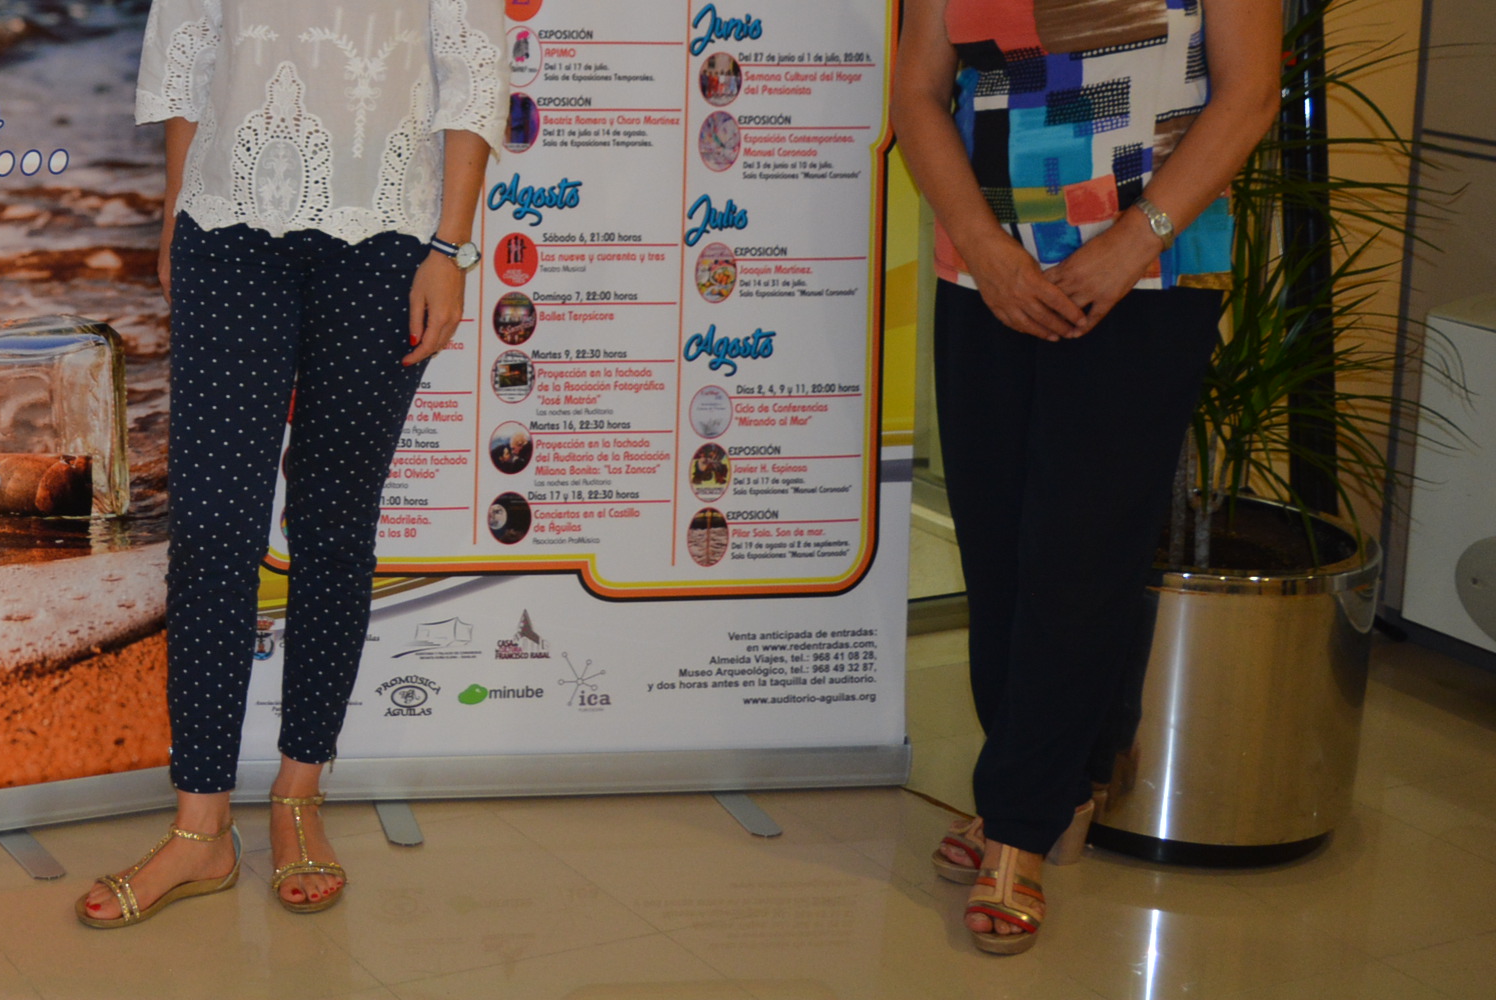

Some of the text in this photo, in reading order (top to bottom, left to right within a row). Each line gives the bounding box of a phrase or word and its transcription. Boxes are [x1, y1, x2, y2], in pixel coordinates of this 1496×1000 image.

[538, 29, 593, 39] EXPOSICIÓN
[690, 3, 763, 56] Junio
[487, 173, 582, 226] Agosto
[684, 194, 748, 247] Julio
[684, 324, 776, 377] Agosto
[414, 399, 458, 410] Orquesta
[416, 412, 463, 422] de Murcia
[728, 445, 781, 455] EXPOSICIÓN
[728, 628, 878, 641] Venta anticipada de entradas:
[488, 686, 543, 699] minube
[578, 692, 611, 706] ica
